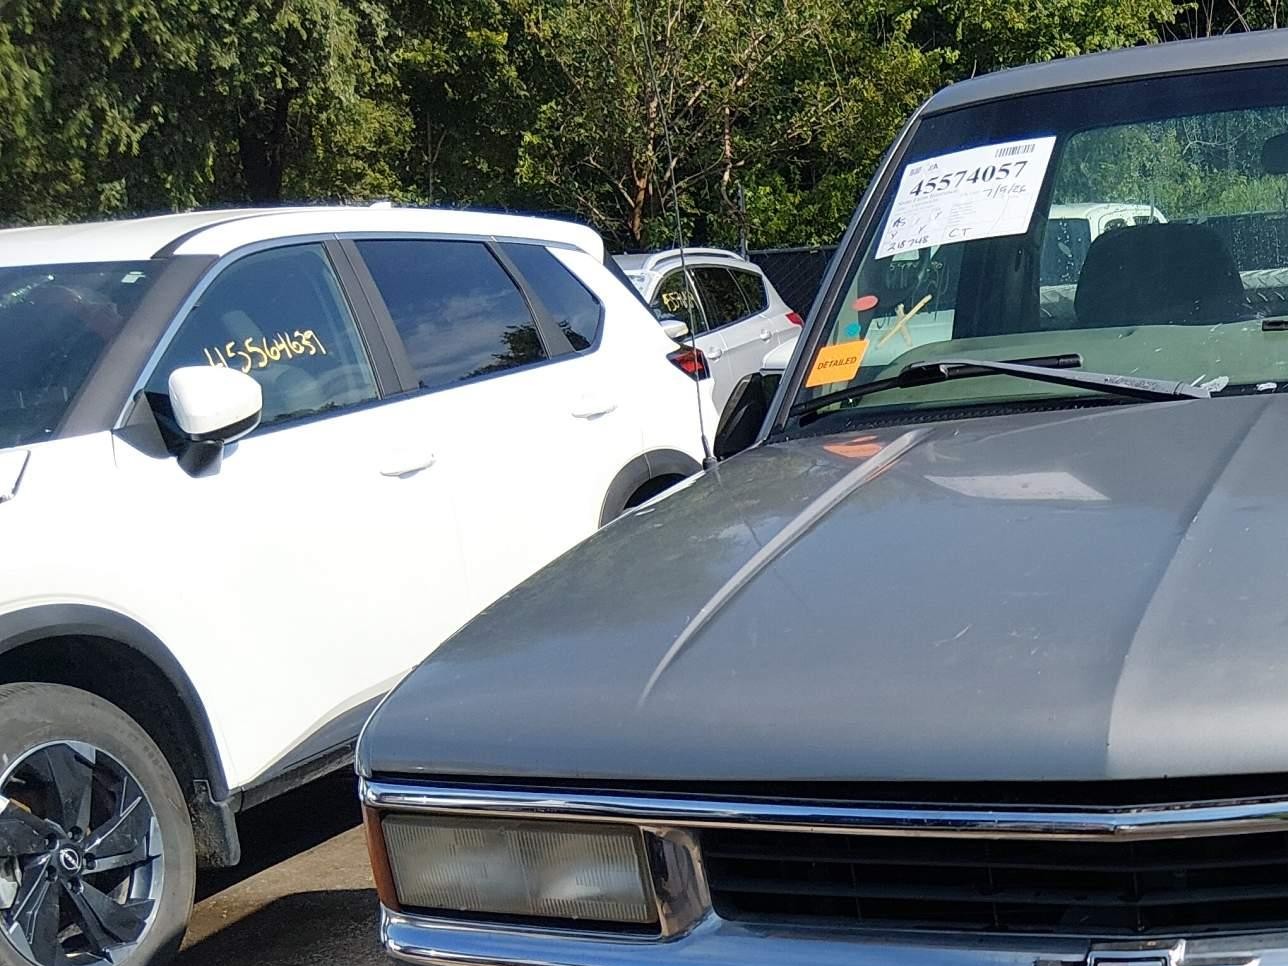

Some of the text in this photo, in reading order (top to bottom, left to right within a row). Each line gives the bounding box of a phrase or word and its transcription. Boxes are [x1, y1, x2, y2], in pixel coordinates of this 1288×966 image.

[909, 160, 1029, 197] 45574057
[203, 329, 327, 375] 45564639
[816, 356, 858, 371] DETAILED
